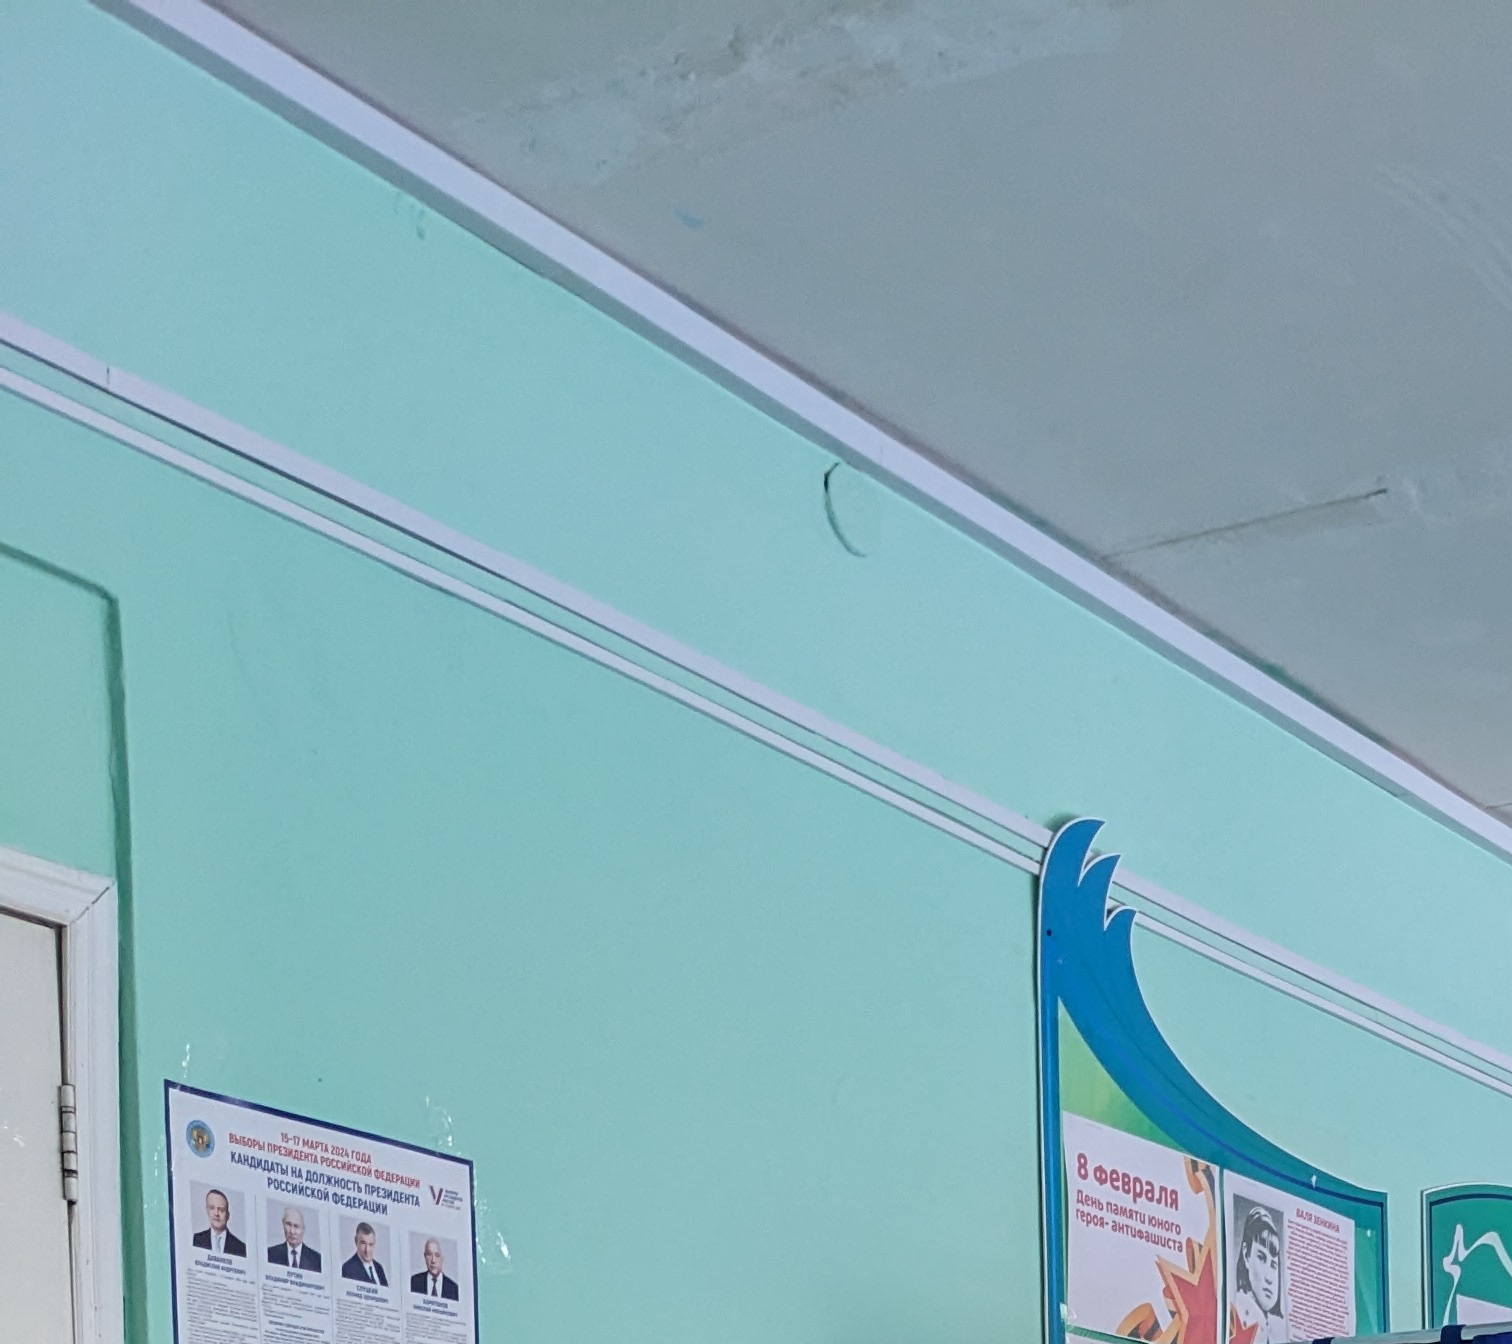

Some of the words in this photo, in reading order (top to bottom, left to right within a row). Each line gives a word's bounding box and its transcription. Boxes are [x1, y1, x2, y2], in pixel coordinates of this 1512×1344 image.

[229, 1133, 266, 1151] ВЫБОРЫ
[267, 1142, 319, 1164] ПРЕЗИДЕНТА
[320, 1155, 372, 1177] РОССИЙСКОЙ
[374, 1169, 420, 1189] ФЕДЕРАЦИИ
[302, 1138, 329, 1153] МАРТА
[331, 1145, 349, 1158] 2024
[351, 1150, 372, 1163] ГОДА
[230, 1151, 289, 1176] КАНДИДАТЫ
[291, 1165, 303, 1179] НА
[305, 1169, 362, 1193] ДОЛЖНОСТЬ
[364, 1183, 420, 1207] ПРЕЗИДЕНТА
[267, 1176, 330, 1201] РОССИЙСКОЙ
[332, 1191, 388, 1215] ФЕДЕРАЦИИ
[1077, 1151, 1088, 1181] 8
[1093, 1162, 1178, 1211] февраля
[1075, 1207, 1108, 1232] героя-
[1111, 1219, 1182, 1253] антифашиста
[1076, 1188, 1103, 1211] День
[1106, 1200, 1145, 1224] памяти
[1148, 1214, 1181, 1236] юного
